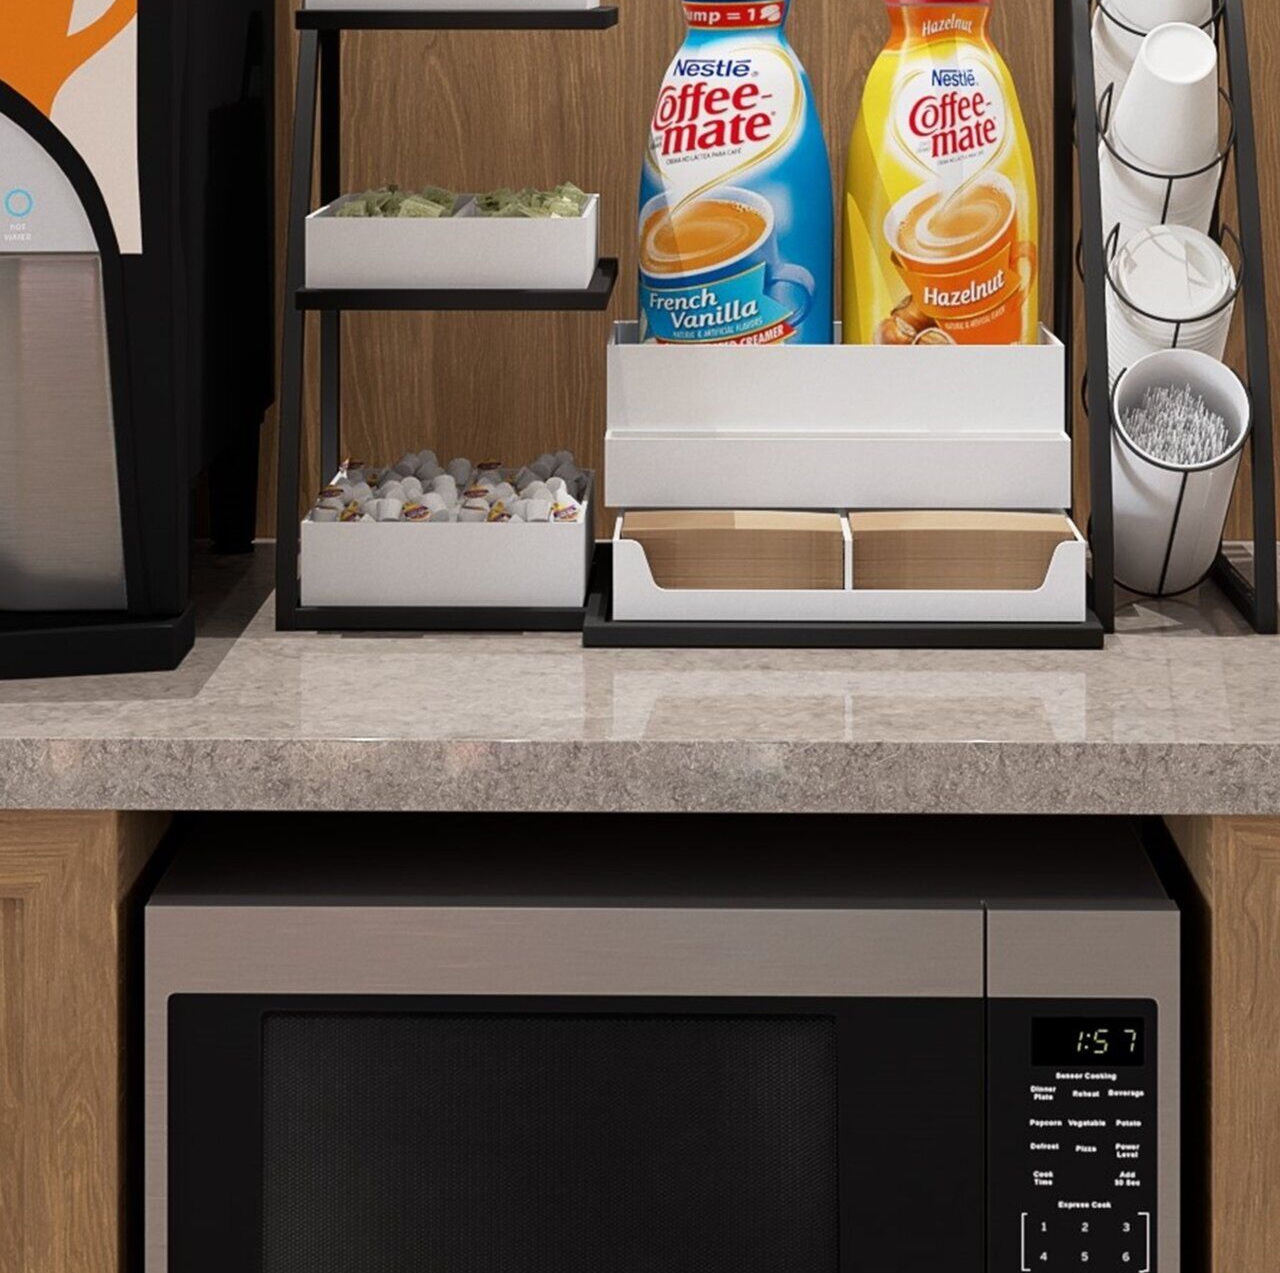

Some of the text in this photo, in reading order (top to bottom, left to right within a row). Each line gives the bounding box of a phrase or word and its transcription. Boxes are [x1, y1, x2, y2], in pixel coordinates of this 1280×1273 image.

[922, 13, 972, 37] Hazelnut
[673, 59, 751, 76] Nestlé
[932, 69, 975, 86] Nestlé
[909, 91, 992, 137] Coffee-
[662, 113, 772, 155] mate
[932, 118, 997, 158] mate
[924, 270, 1005, 307] Hazelnut
[650, 288, 717, 310] French
[670, 300, 758, 328] Vanilla
[1055, 1072, 1117, 1081] Sensor Cooking
[1030, 1085, 1057, 1093] Dinner
[1108, 1089, 1144, 1098] Beverage
[1033, 1093, 1054, 1101] Plate
[1072, 1090, 1100, 1098] Reheat
[1029, 1119, 1062, 1128] Popcorn
[1068, 1119, 1106, 1128] Vegetable
[1115, 1119, 1142, 1128] Potato
[1030, 1142, 1060, 1150] Defrost
[1075, 1144, 1097, 1153] Pizza
[1115, 1143, 1140, 1151] Power
[1116, 1151, 1138, 1159] Level
[1033, 1178, 1053, 1186] Time
[1091, 1201, 1112, 1209] Cook
[1041, 1222, 1047, 1232] 1
[1081, 1222, 1089, 1232] 2
[1122, 1222, 1130, 1232] 3
[1040, 1252, 1048, 1261] 4
[1081, 1251, 1089, 1262] 5
[1122, 1252, 1130, 1262] 6
